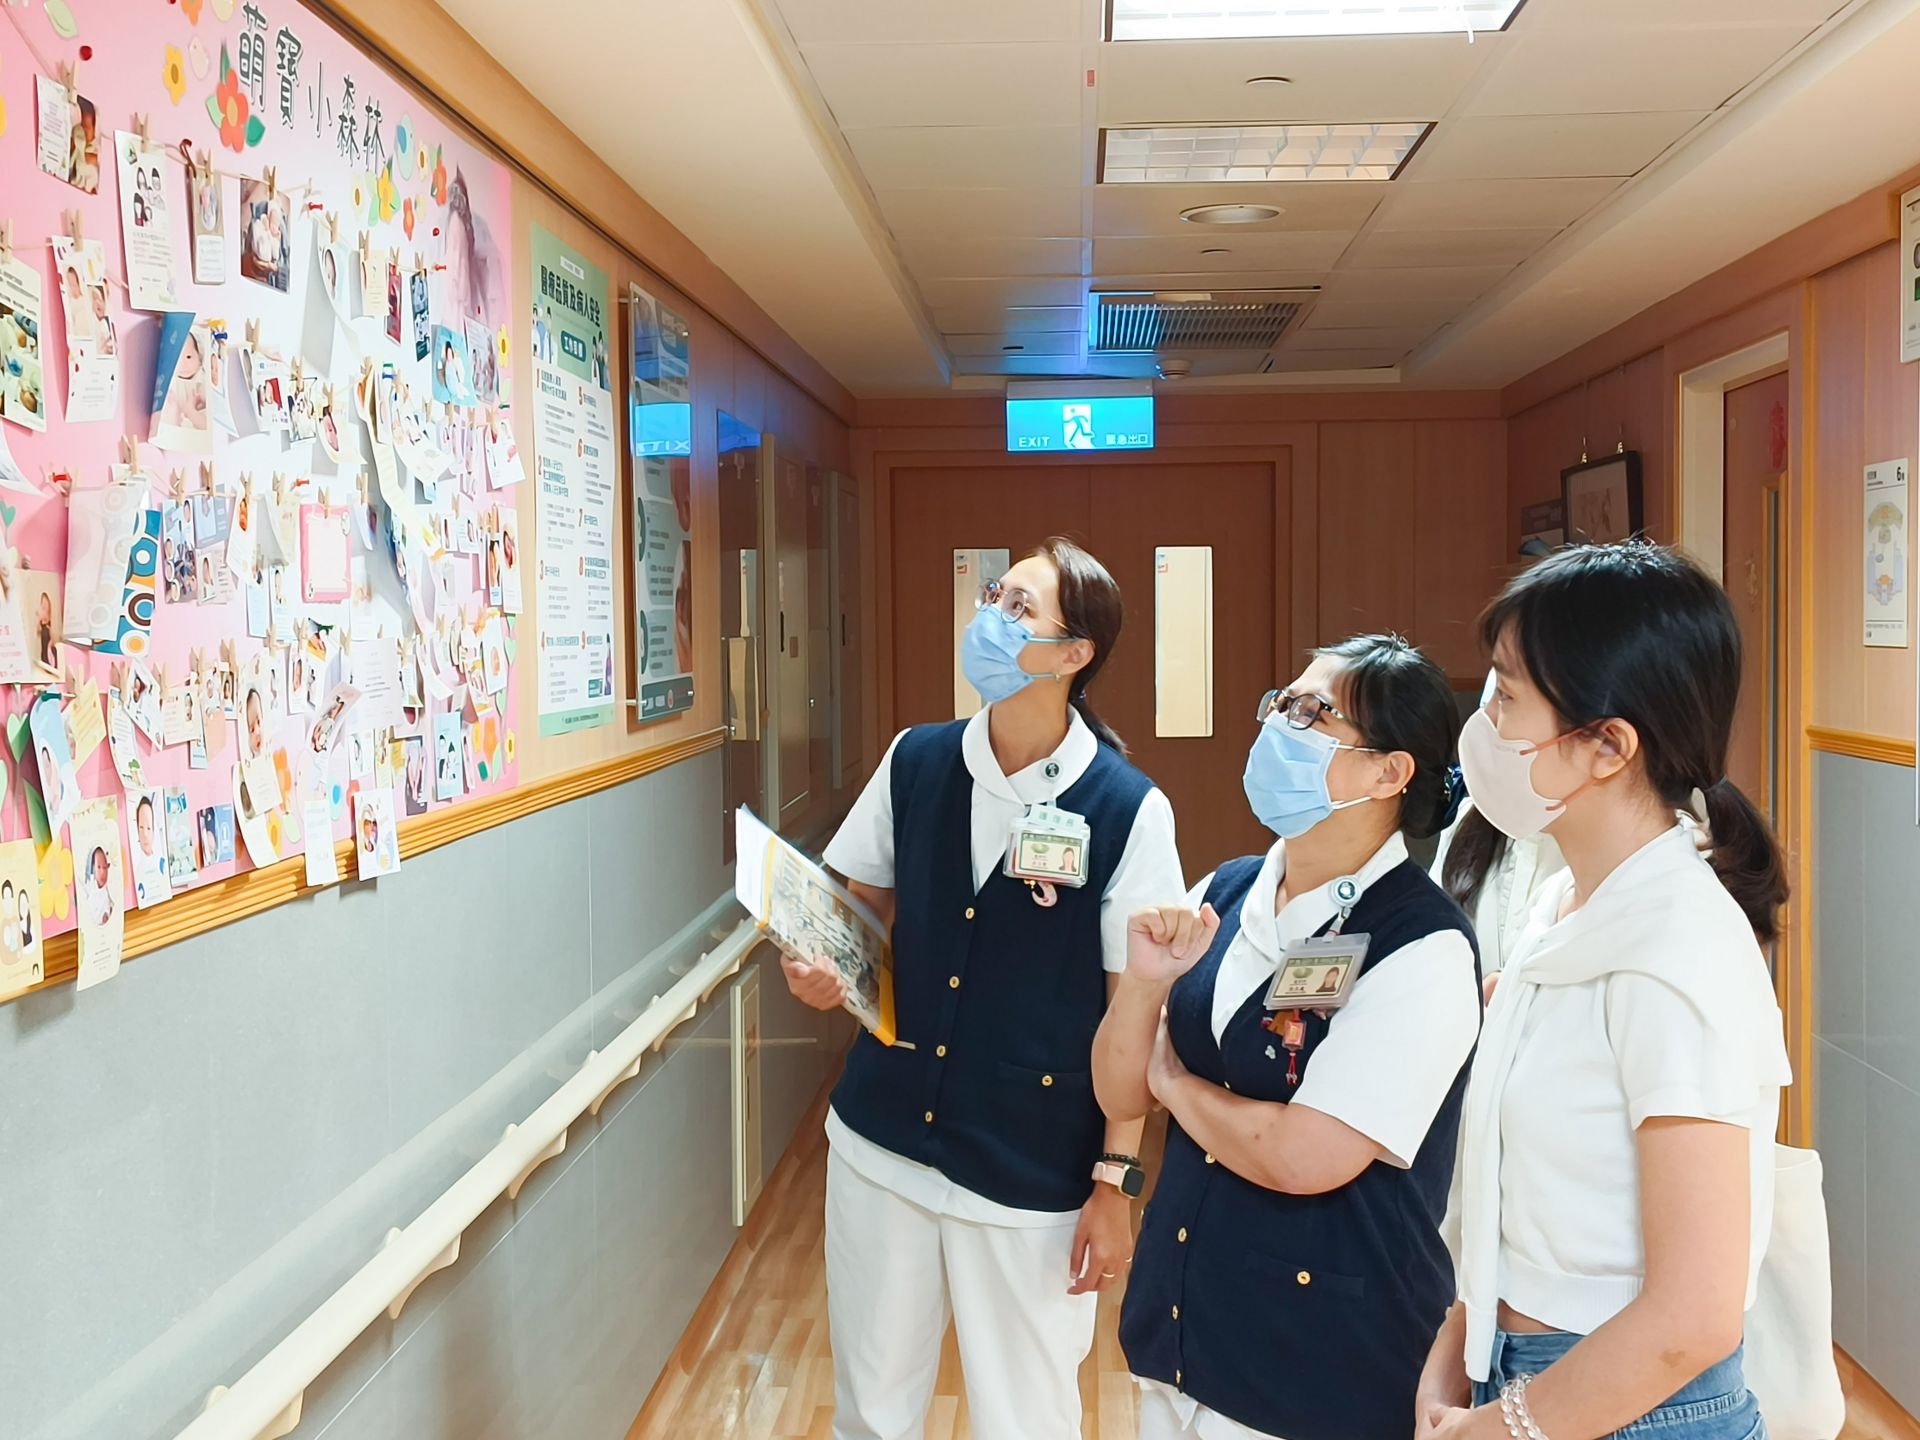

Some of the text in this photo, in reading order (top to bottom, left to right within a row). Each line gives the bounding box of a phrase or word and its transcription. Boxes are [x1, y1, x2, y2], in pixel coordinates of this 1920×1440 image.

[239, 1, 386, 174] 萌寶小森林
[1018, 436, 1050, 448] EXIT
